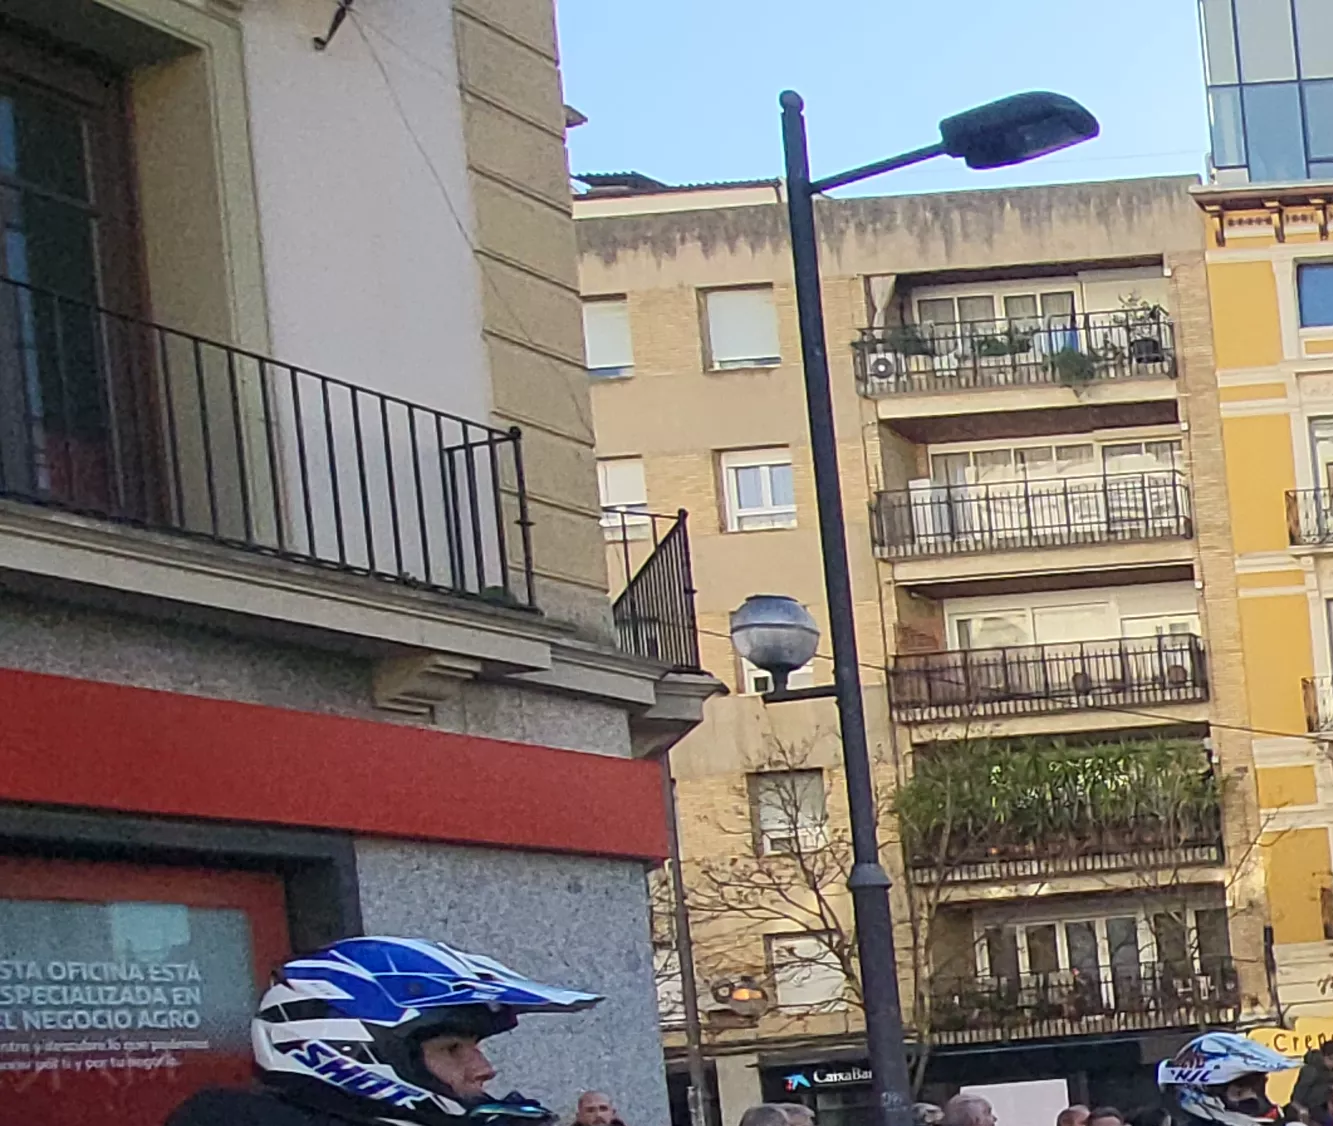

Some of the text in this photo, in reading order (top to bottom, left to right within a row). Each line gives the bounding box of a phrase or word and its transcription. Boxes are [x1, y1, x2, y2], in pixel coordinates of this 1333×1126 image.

[51, 962, 144, 981] OFICINA
[172, 987, 202, 1005] EN
[22, 1010, 132, 1031] NEGOCIO
[138, 1010, 200, 1029] AGRO
